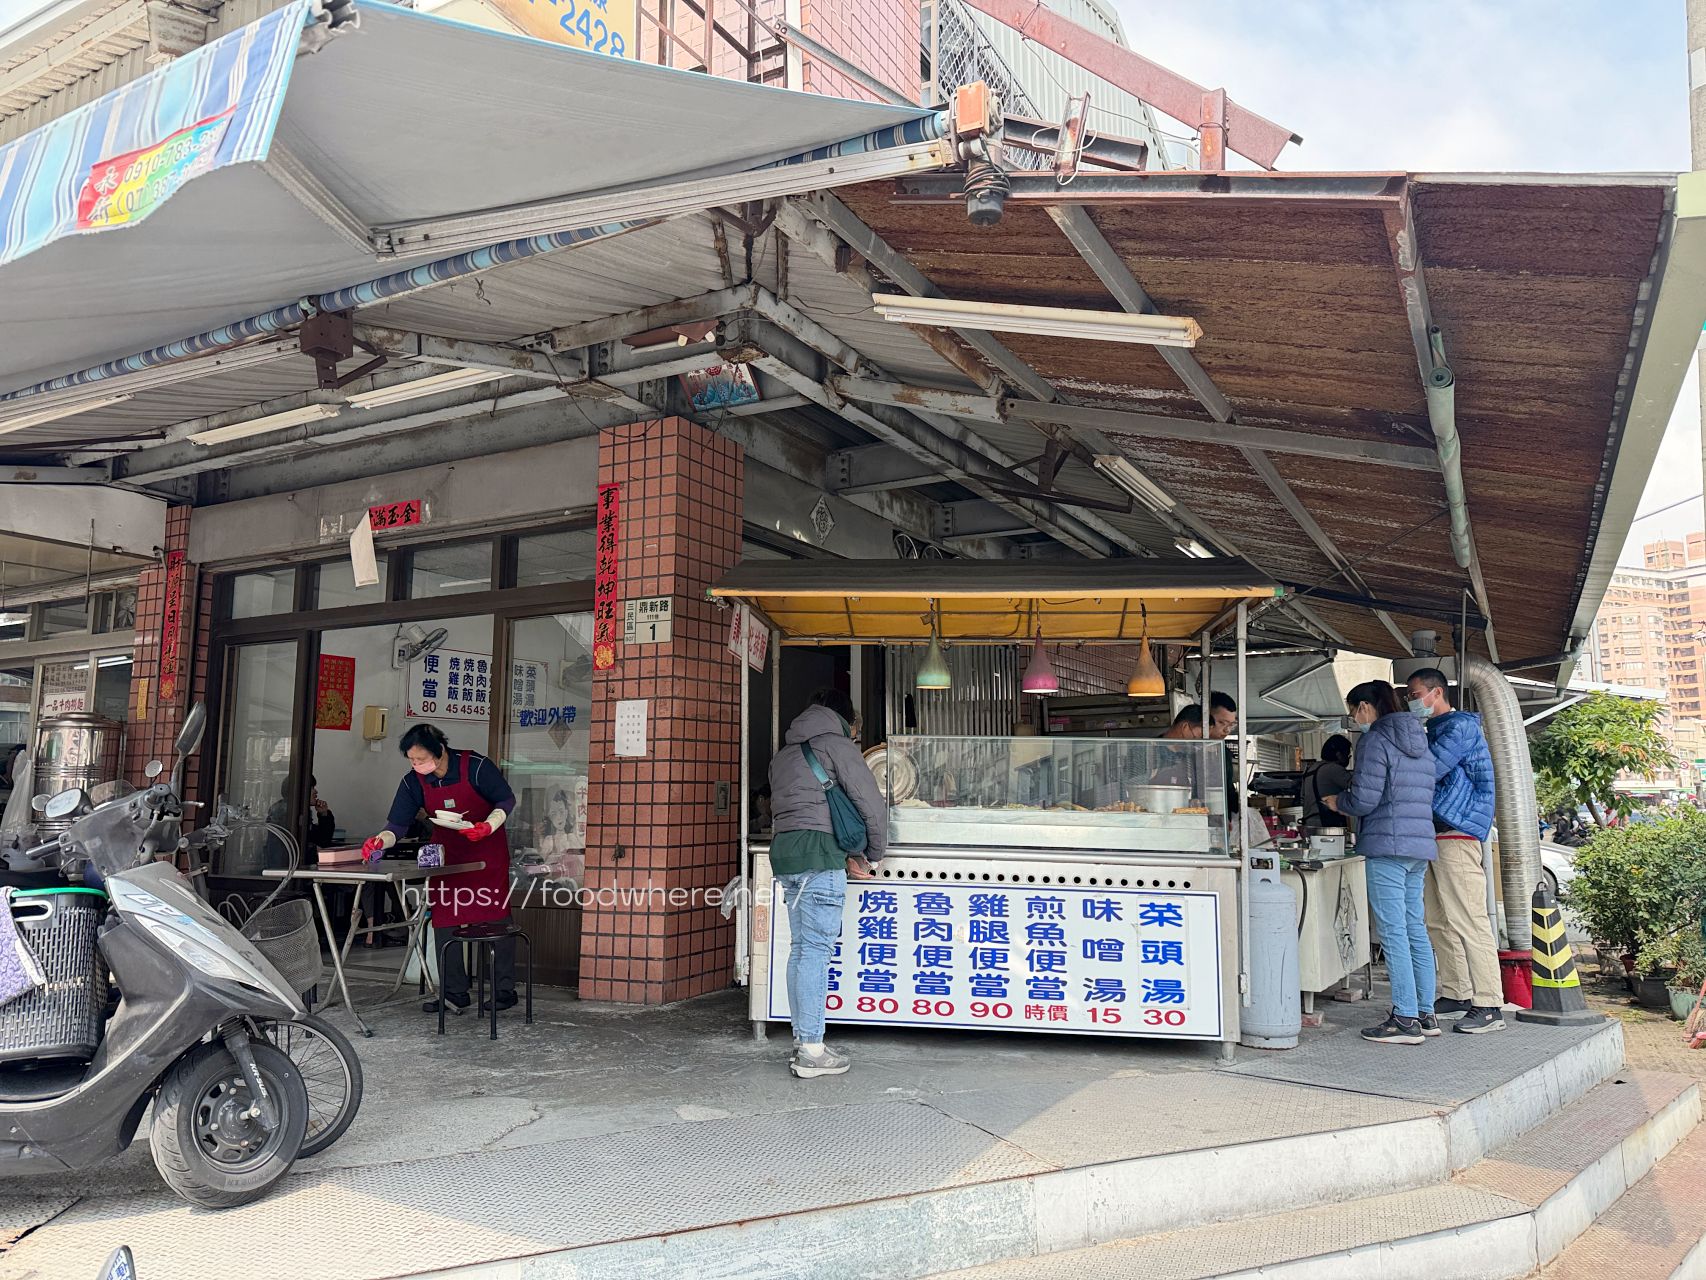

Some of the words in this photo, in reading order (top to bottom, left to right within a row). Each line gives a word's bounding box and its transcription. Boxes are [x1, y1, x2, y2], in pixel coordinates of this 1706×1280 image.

[369, 502, 416, 527] 金玉滿
[639, 600, 669, 613] 鼎新路
[649, 623, 656, 640] 1
[422, 655, 440, 699] 便當
[422, 701, 437, 713] 80
[445, 704, 458, 714] 45
[460, 704, 473, 715] 45
[474, 705, 485, 716] 45
[519, 706, 577, 727] 歡迎外帶
[912, 891, 954, 996] 魯肉便當
[968, 893, 1010, 998] 雞腿便當
[1025, 896, 1067, 1001] 煎魚便當
[1082, 898, 1126, 1003] 味噌湯
[1139, 902, 1185, 1004] 菜頭湯
[826, 994, 843, 1011] 0
[856, 996, 899, 1014] 80
[911, 999, 955, 1017] 80
[969, 1002, 1013, 1019] 90
[1024, 1004, 1068, 1022] 時價
[1086, 1008, 1122, 1024] 15
[1143, 1009, 1186, 1026] 30
